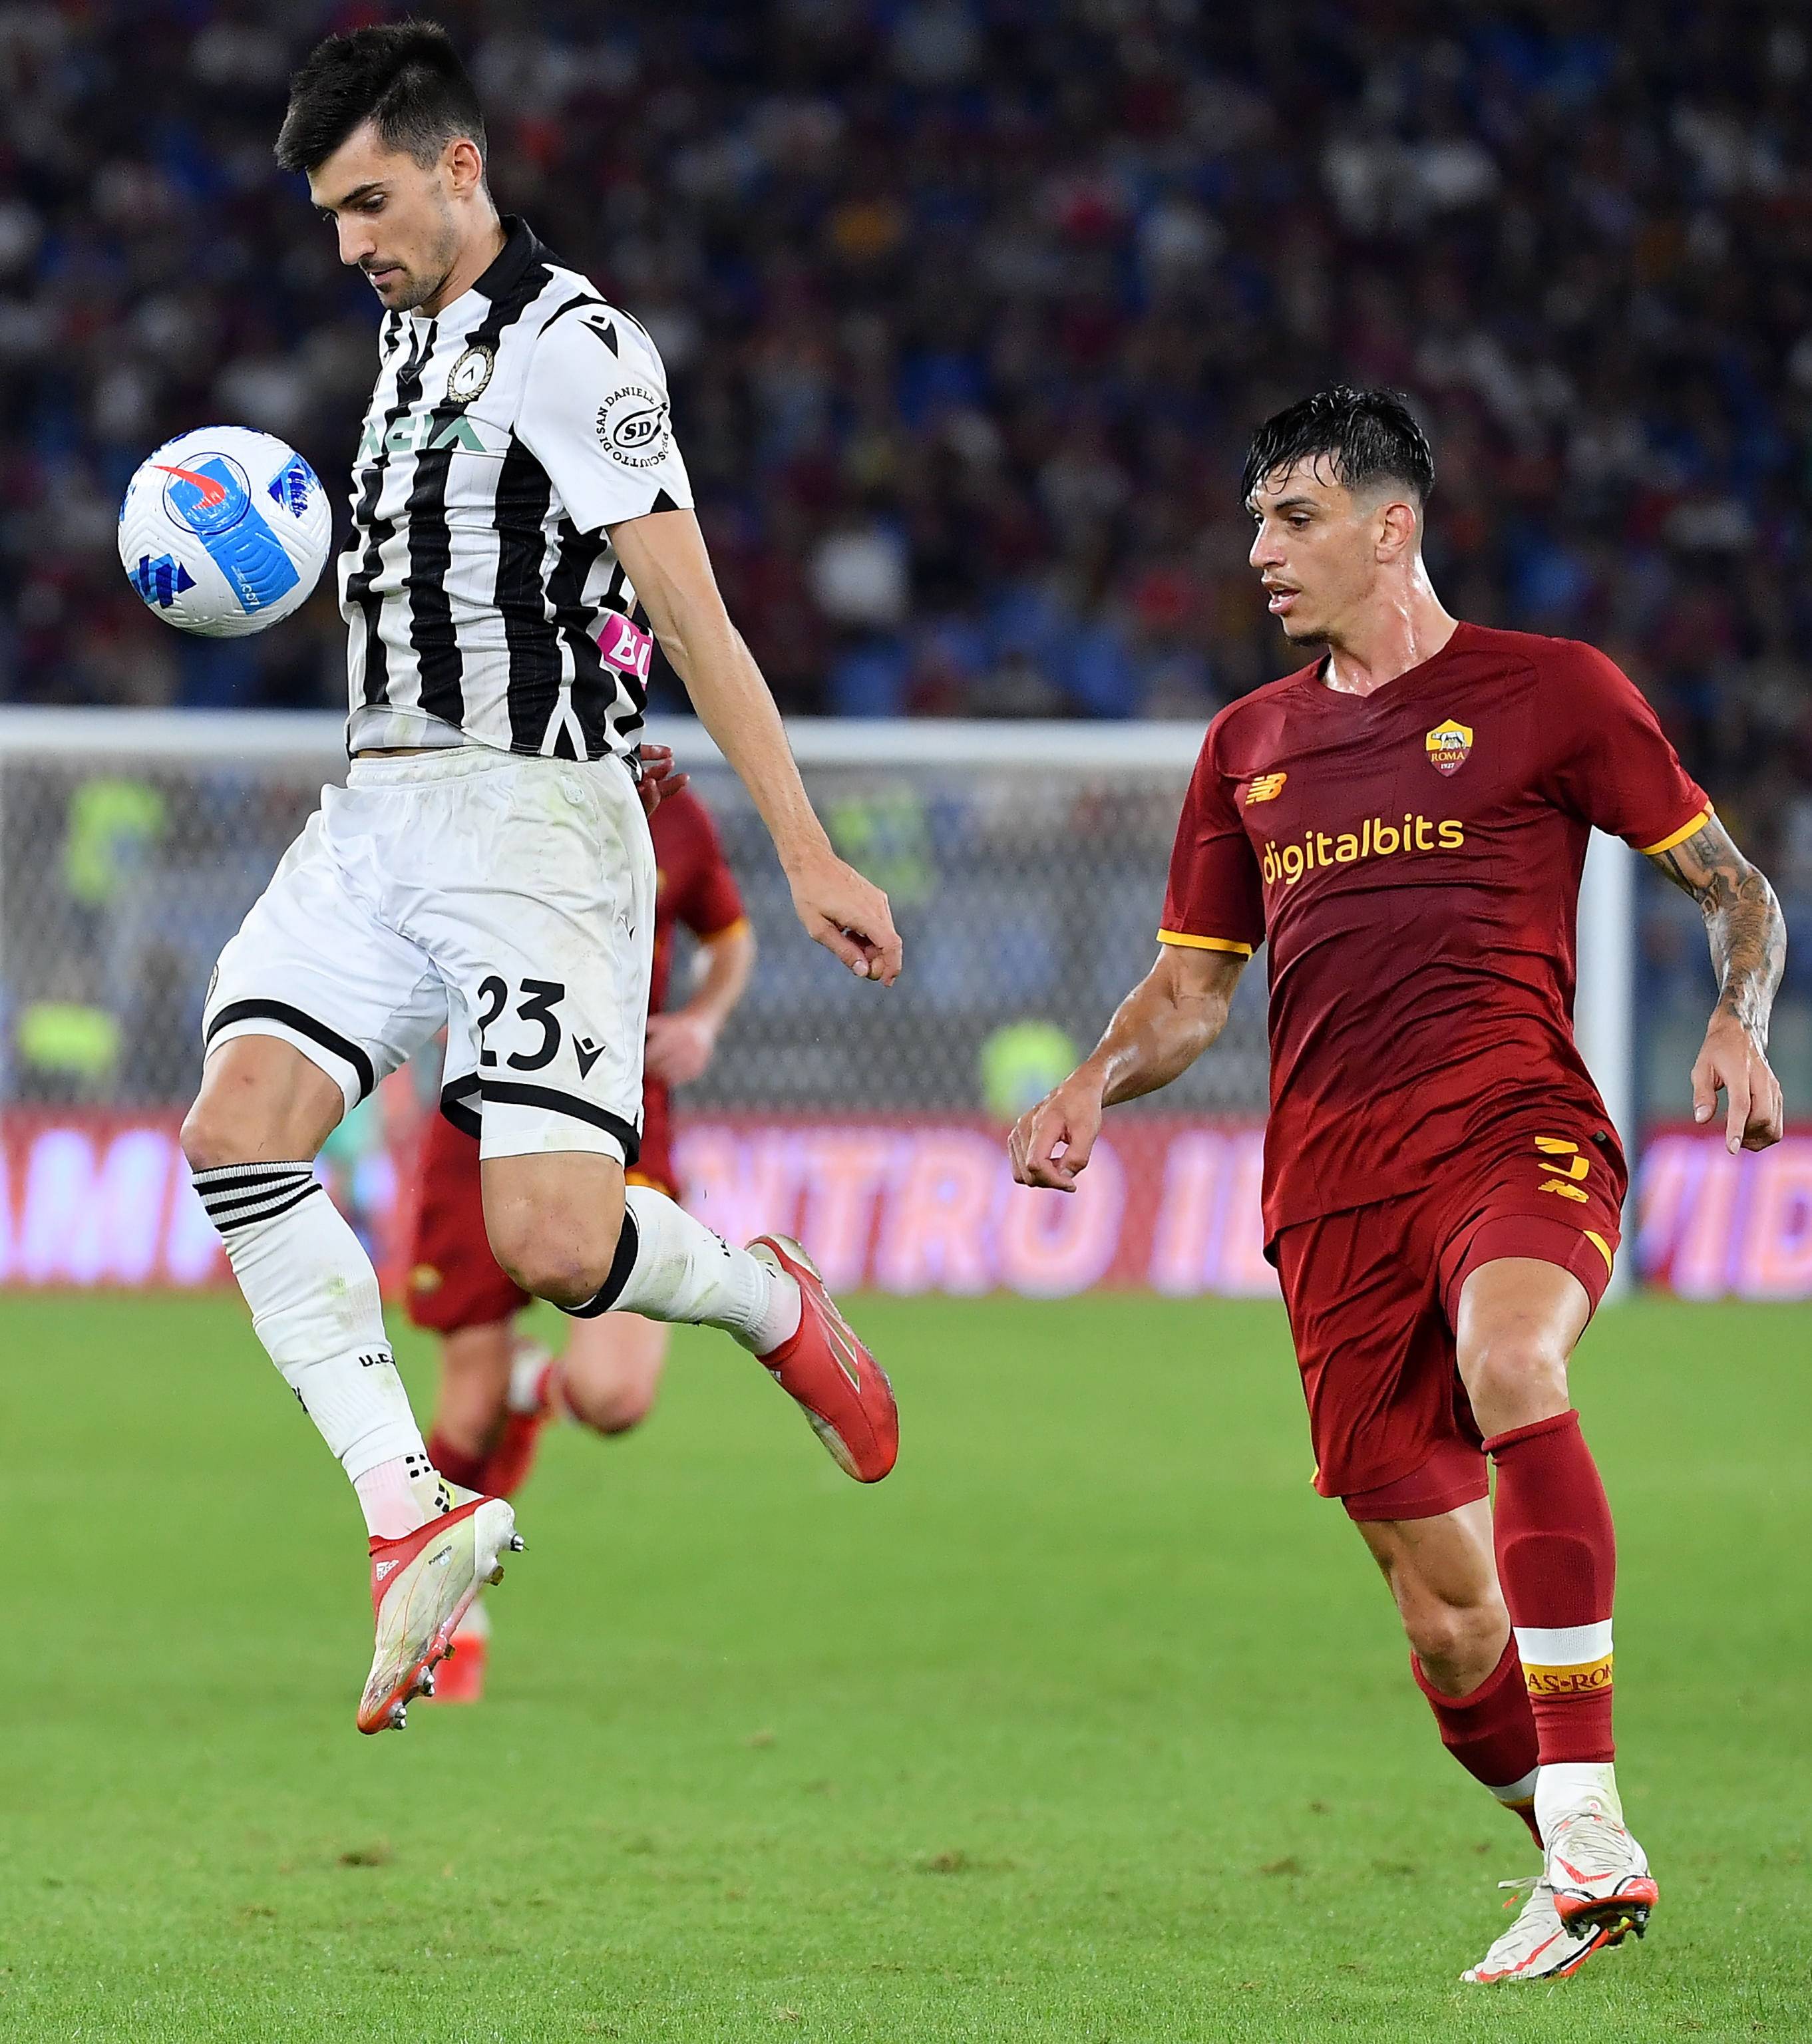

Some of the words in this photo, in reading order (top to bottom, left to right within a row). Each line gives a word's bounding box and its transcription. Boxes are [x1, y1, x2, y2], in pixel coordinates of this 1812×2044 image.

[596, 407, 608, 434] SAN
[624, 421, 651, 440] SD
[356, 413, 487, 460] ACIA
[600, 436, 613, 452] DI
[1431, 751, 1465, 763] ROMA
[1263, 812, 1465, 886] digitalbits
[477, 975, 565, 1071] 23
